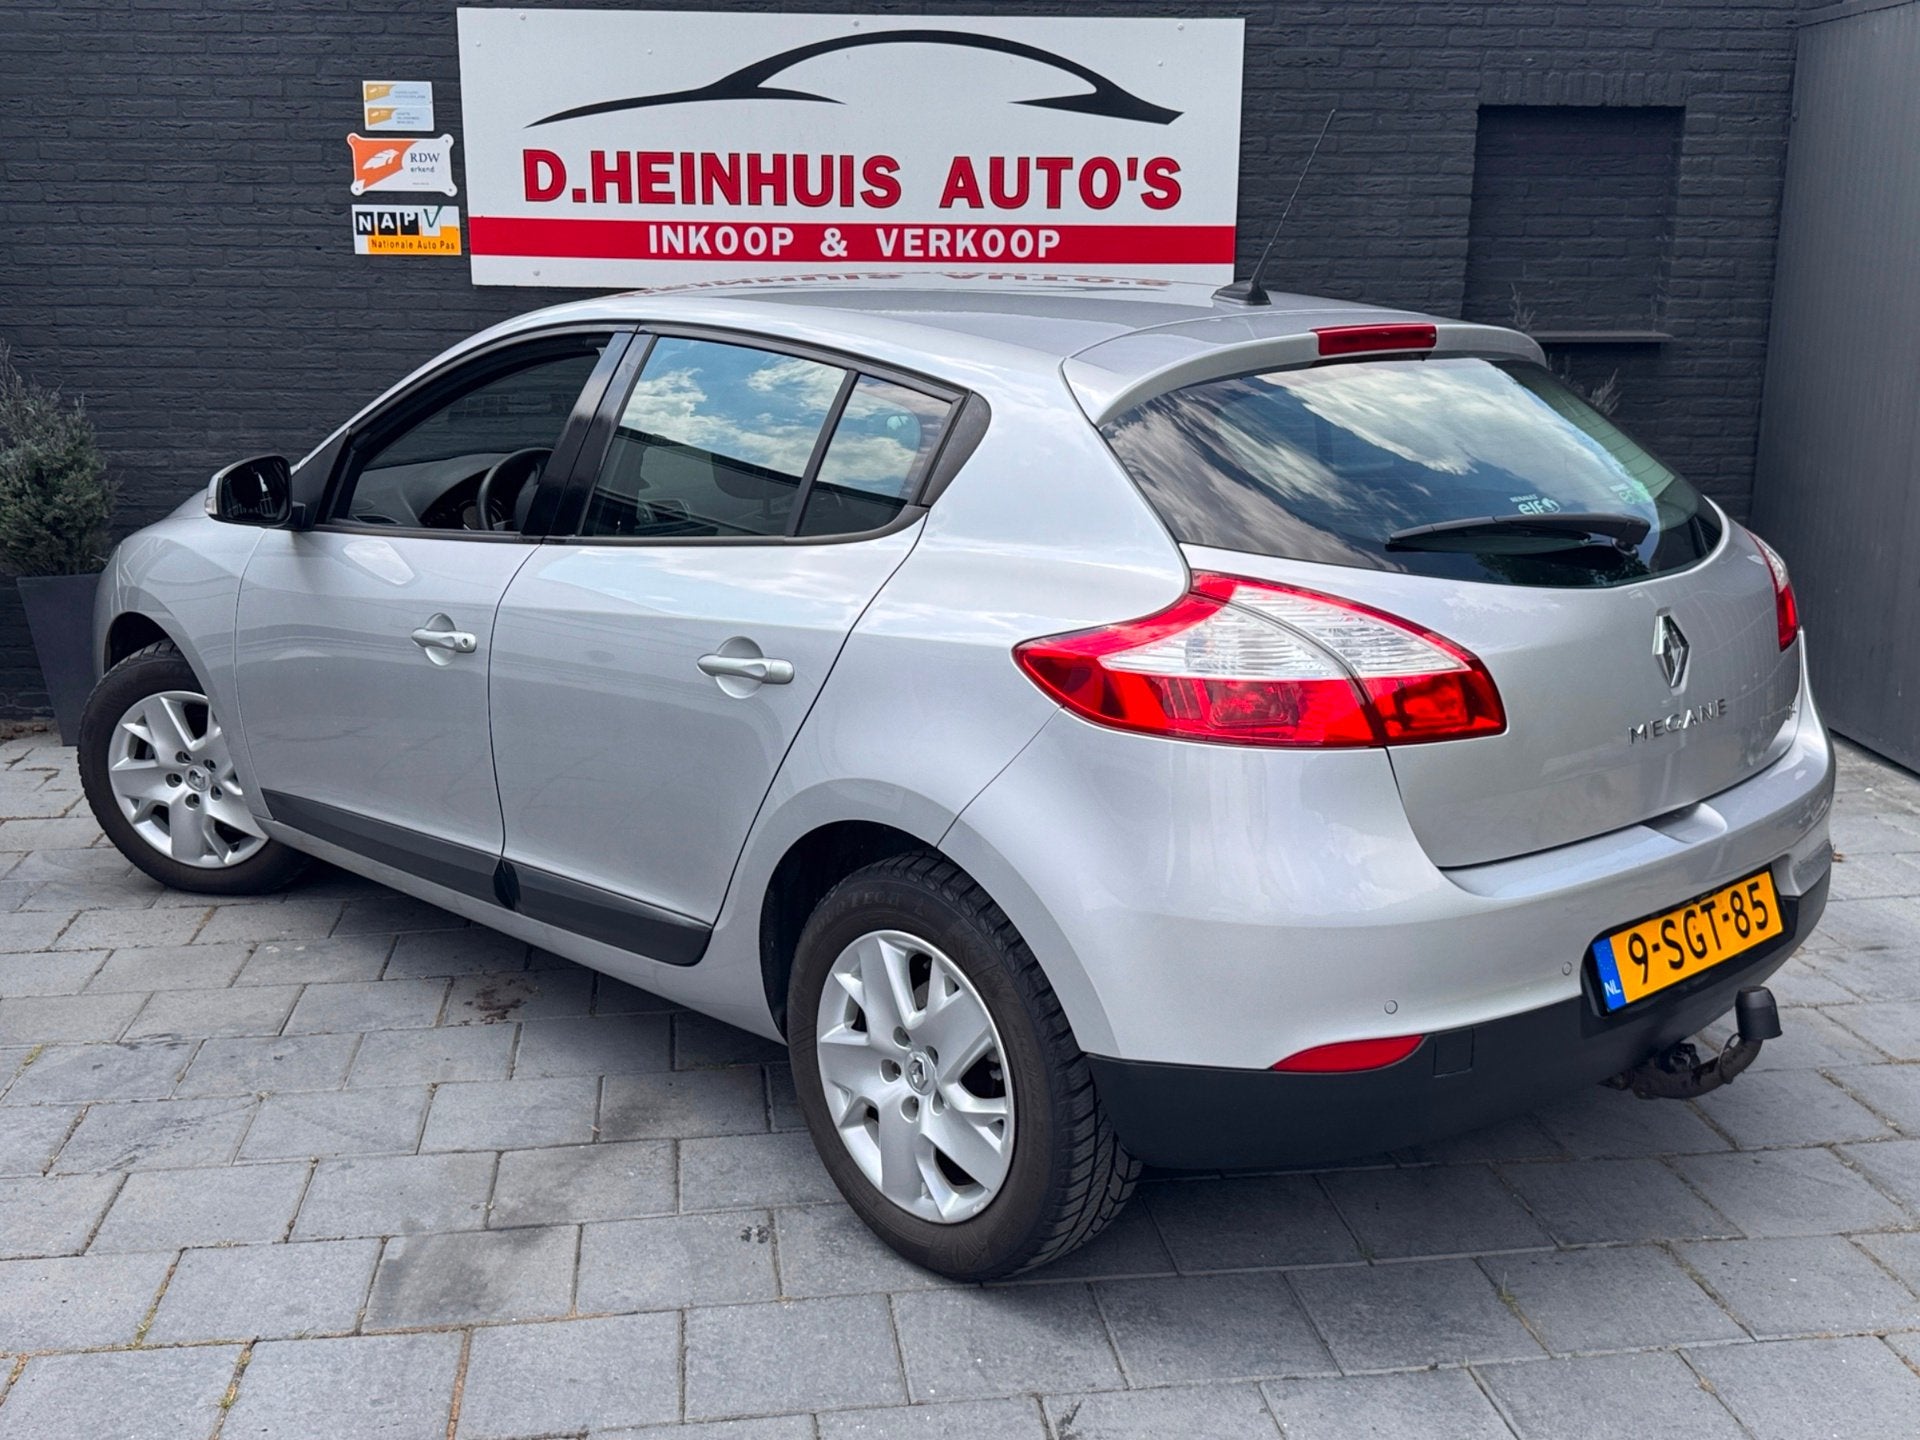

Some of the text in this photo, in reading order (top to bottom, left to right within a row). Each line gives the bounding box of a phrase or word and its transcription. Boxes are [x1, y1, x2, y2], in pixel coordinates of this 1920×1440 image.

[410, 152, 440, 163] RDW
[523, 148, 1182, 211] D.HEINHUIS AUTO'S
[371, 239, 456, 251] Nationale Auto Pas
[648, 224, 1060, 259] INKOOP & VERKOOP
[1627, 881, 1769, 986] 9-SGT-85
[1604, 979, 1622, 998] NL
